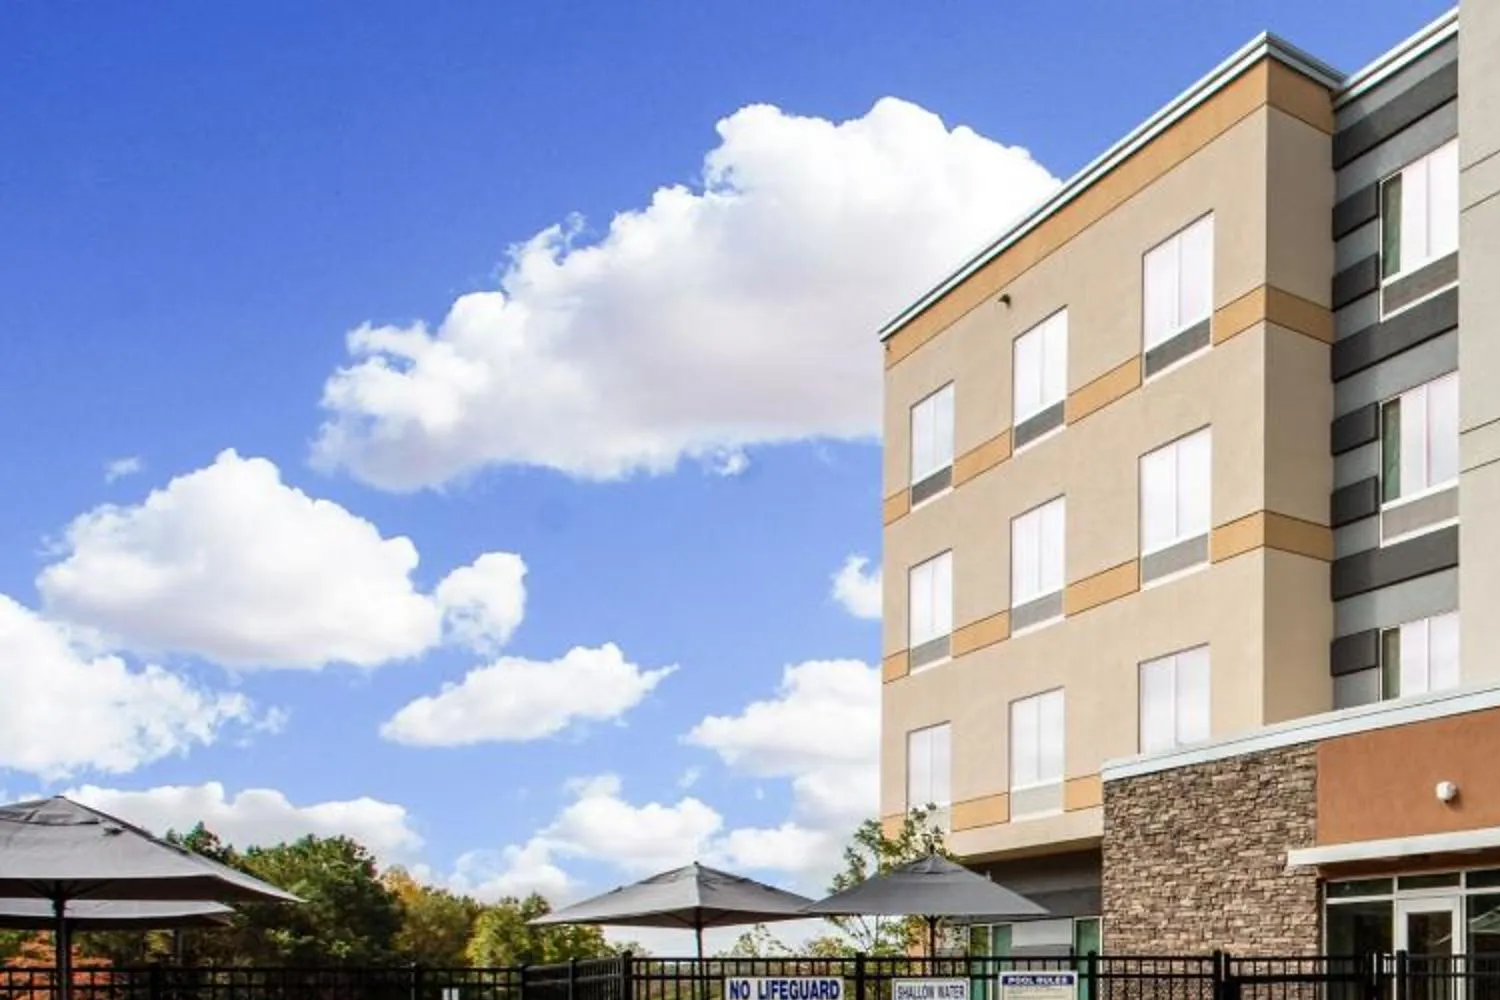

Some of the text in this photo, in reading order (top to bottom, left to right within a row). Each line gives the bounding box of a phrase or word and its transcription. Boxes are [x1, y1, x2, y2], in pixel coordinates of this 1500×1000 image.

[730, 980, 840, 1000] NO LIFEGUARD
[898, 985, 964, 999] SHALLOW WATER
